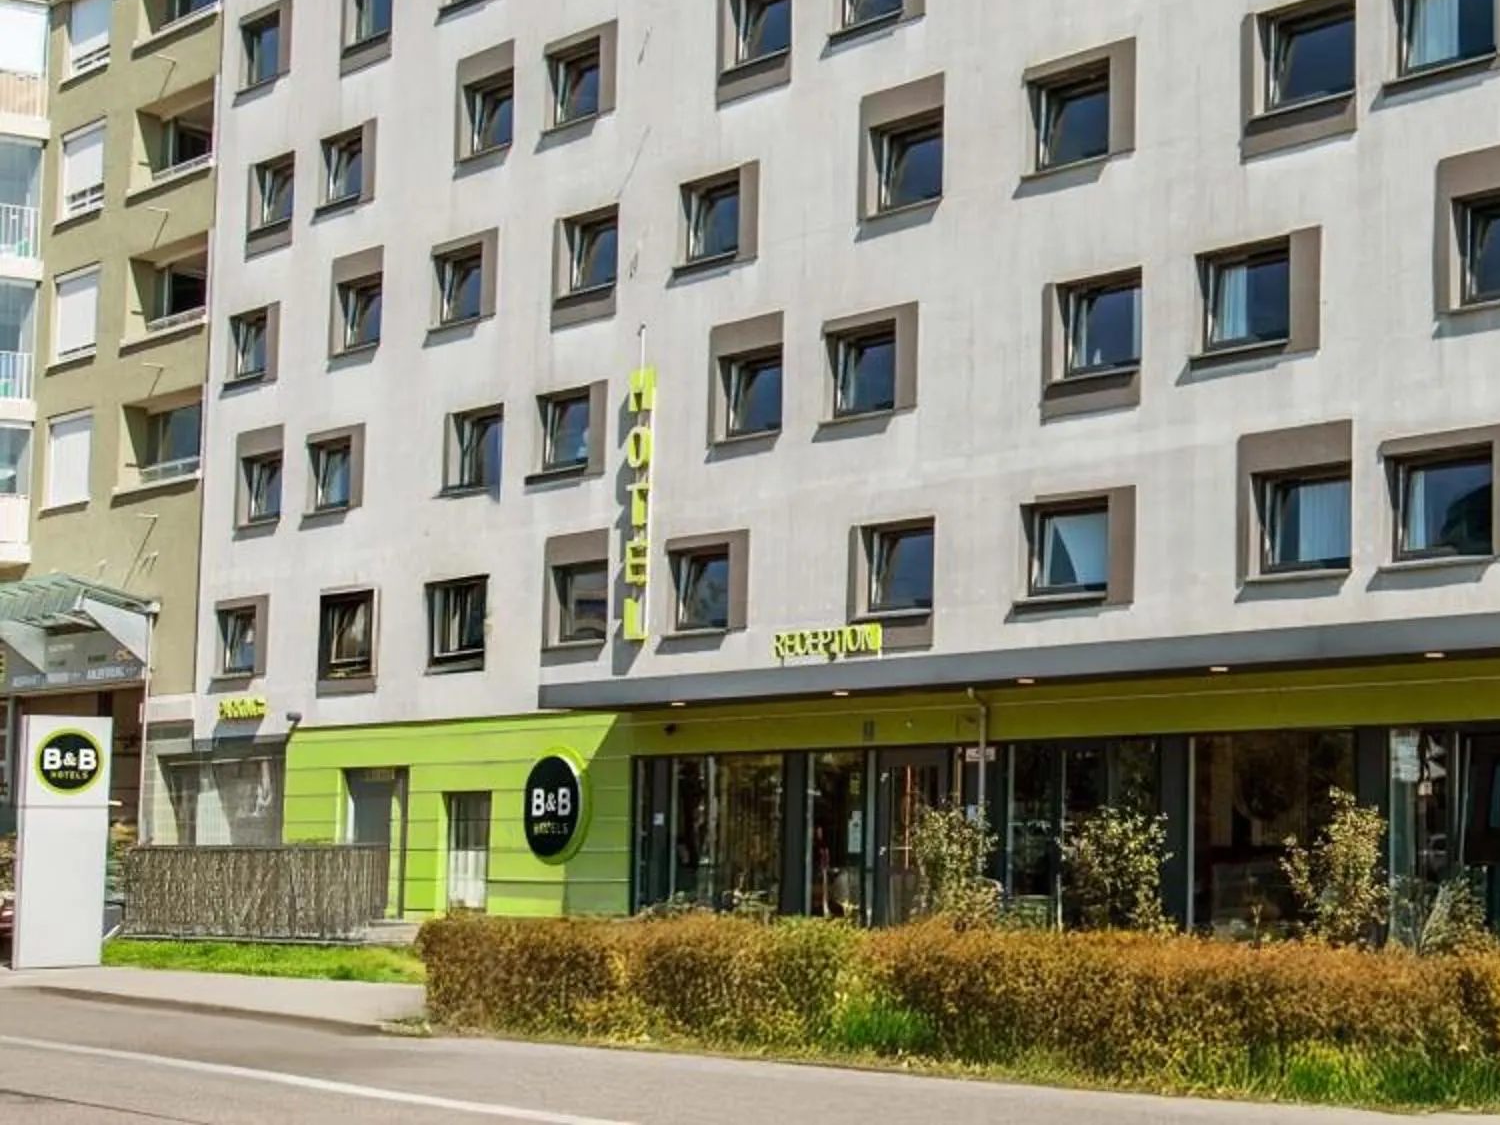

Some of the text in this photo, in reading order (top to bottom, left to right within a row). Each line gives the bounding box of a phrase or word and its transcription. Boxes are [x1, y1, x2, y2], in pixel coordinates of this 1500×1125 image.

[623, 365, 657, 641] HOTEL
[773, 622, 882, 658] RECEPTION
[43, 747, 97, 770] B&B
[50, 770, 89, 780] HOTELS
[531, 787, 571, 816] B&B
